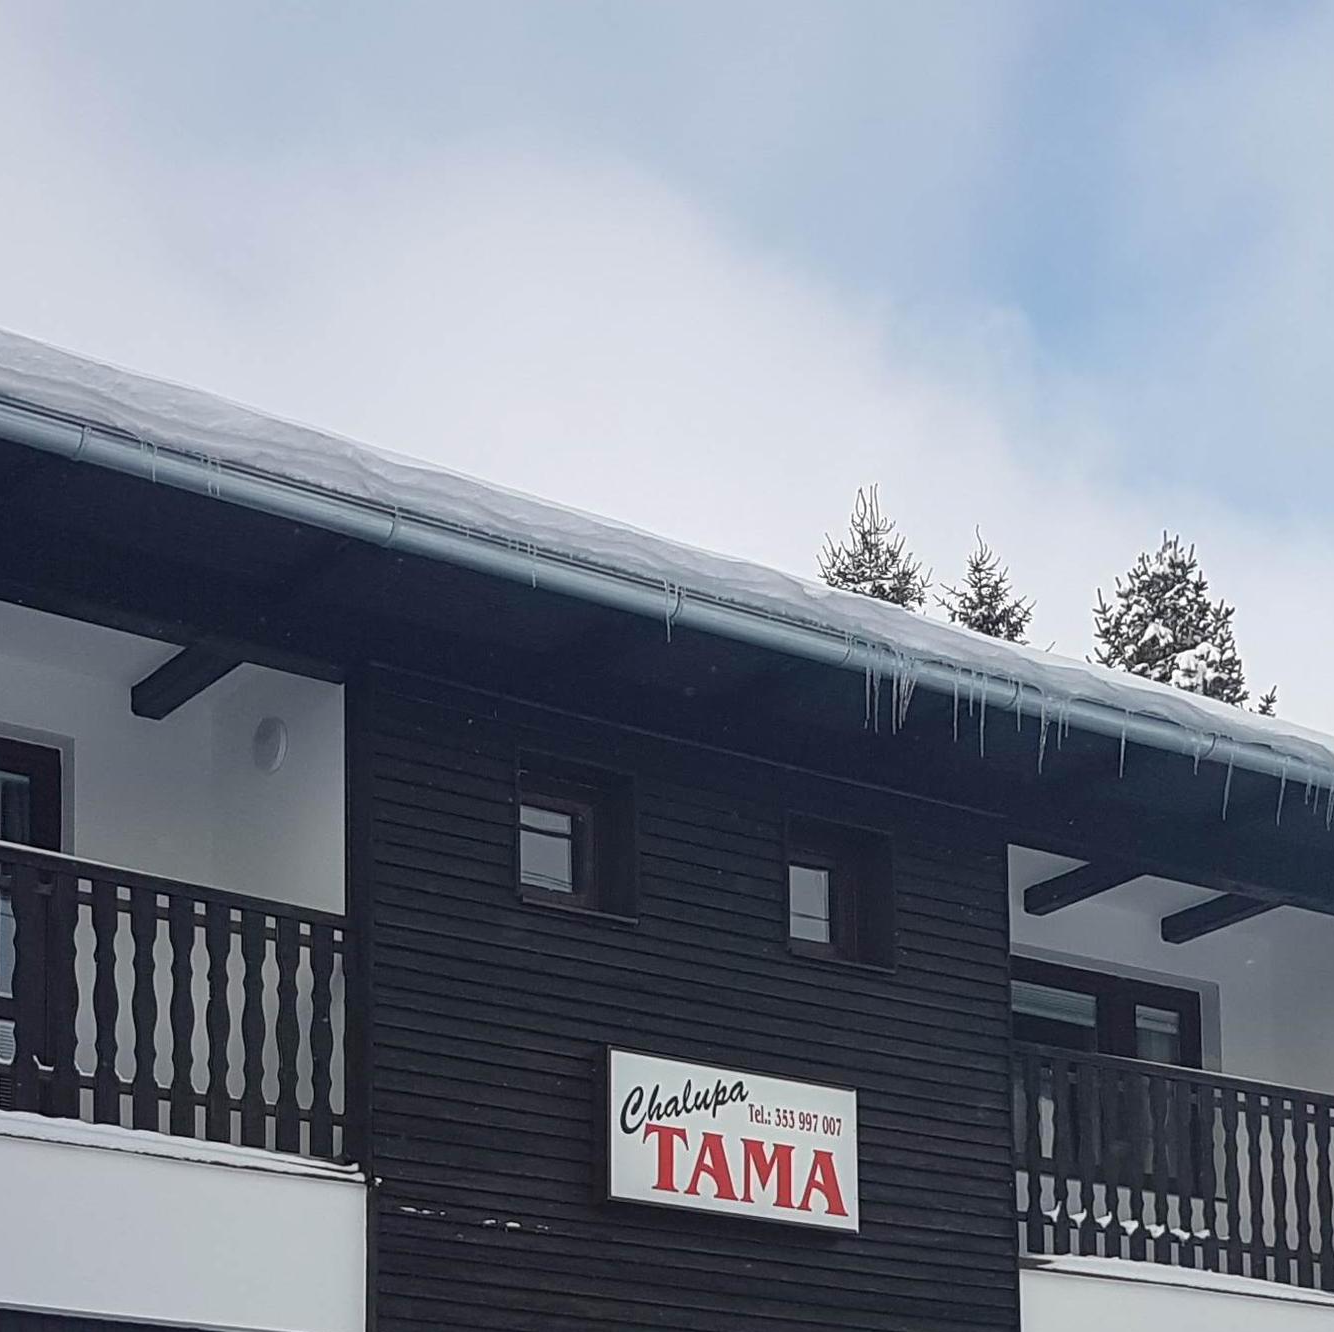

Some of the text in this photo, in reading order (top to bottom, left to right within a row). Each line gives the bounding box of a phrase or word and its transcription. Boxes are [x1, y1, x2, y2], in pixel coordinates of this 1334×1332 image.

[620, 1079, 749, 1134] Chalupa
[748, 1103, 842, 1136] Tel.: 353 997 007
[643, 1123, 848, 1217] TAMA
